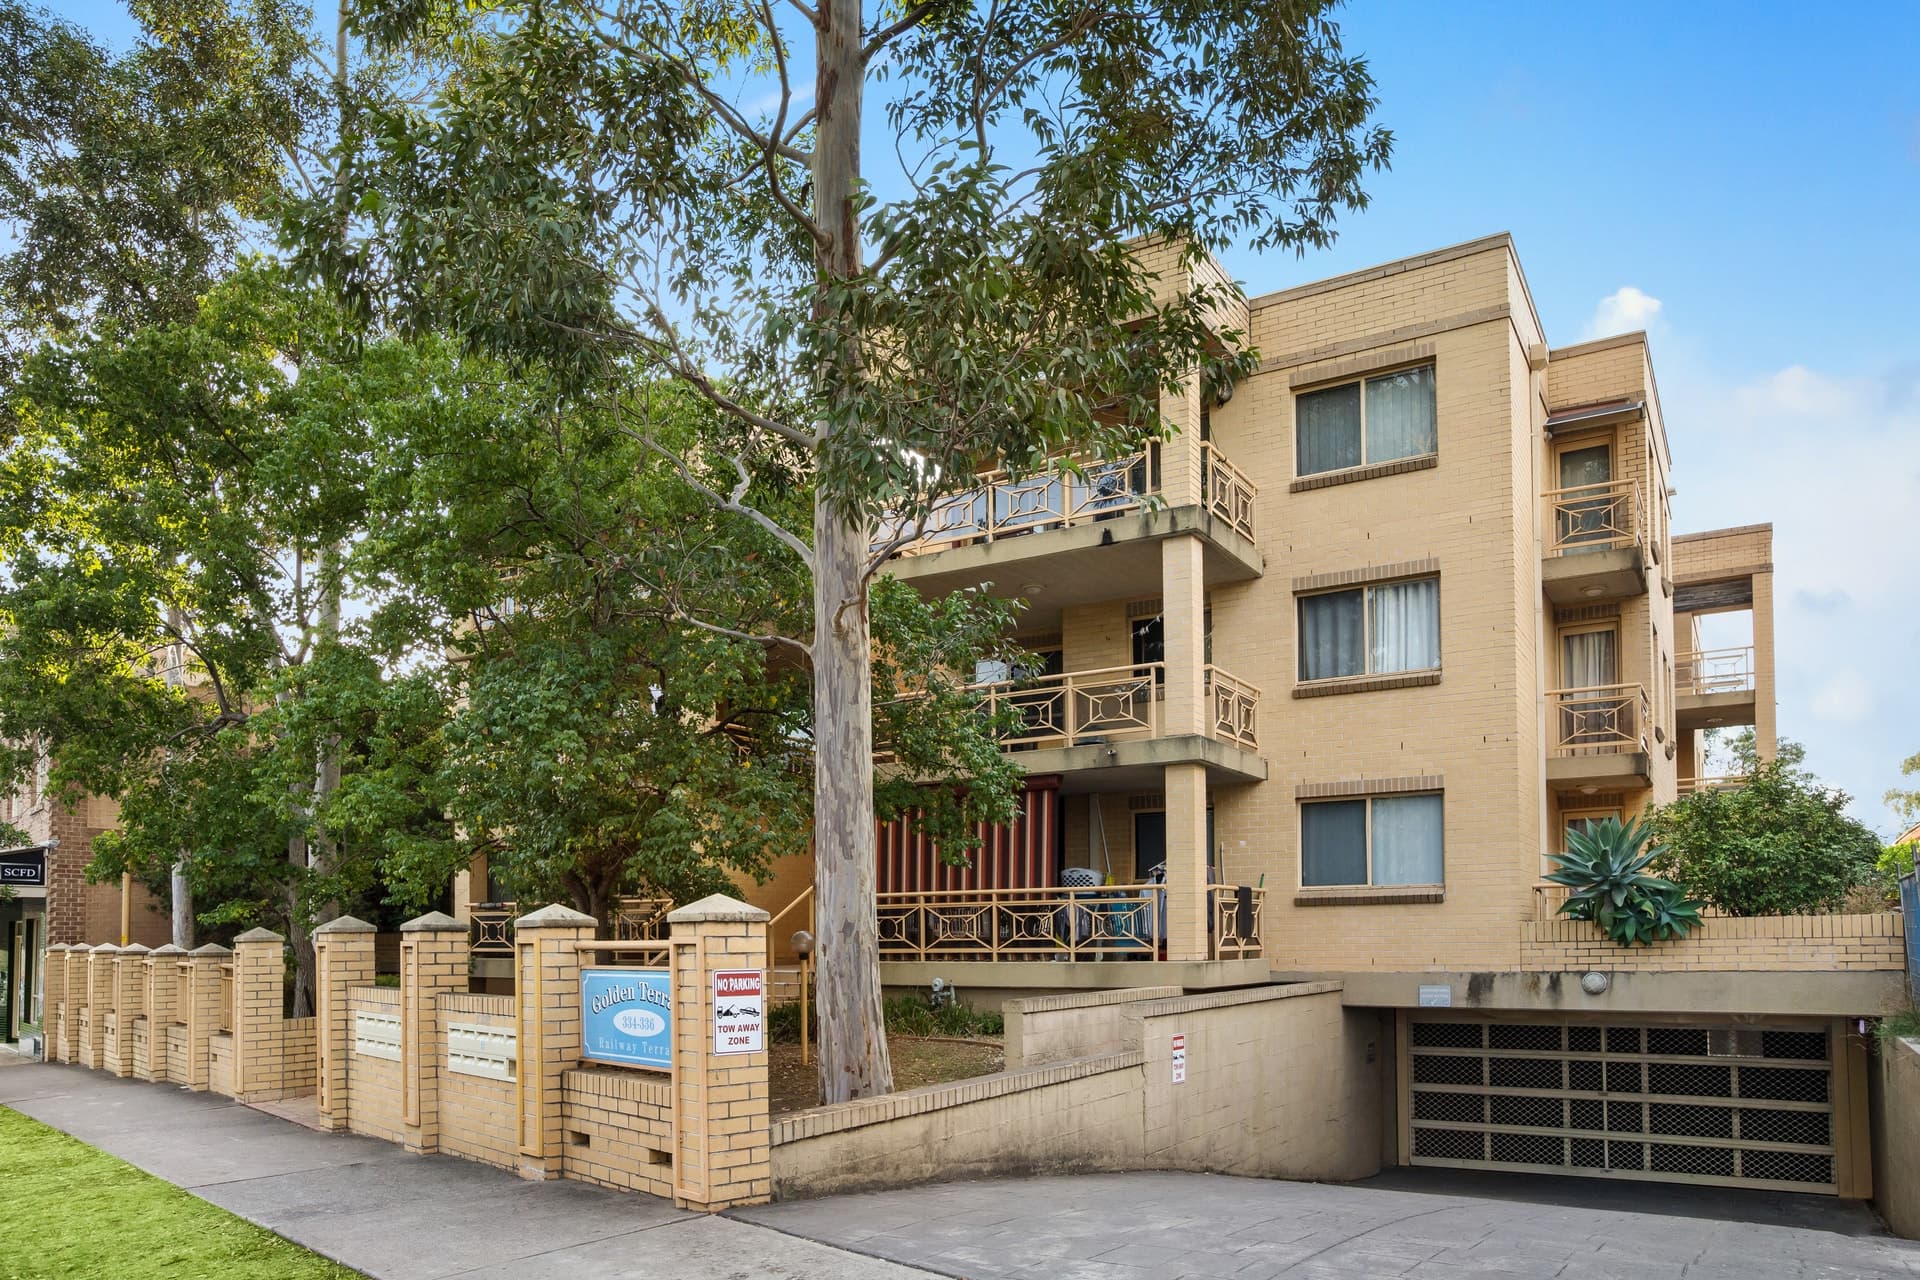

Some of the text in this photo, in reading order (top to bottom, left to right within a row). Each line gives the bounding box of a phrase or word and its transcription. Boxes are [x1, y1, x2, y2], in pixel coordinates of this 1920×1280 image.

[4, 868, 36, 877] SCFD
[718, 977, 760, 991] NO PARKING
[592, 984, 635, 1014] Golden
[622, 1015, 655, 1031] 334-336
[718, 1023, 760, 1033] TOW AWAY
[600, 1037, 637, 1054] Railway
[728, 1036, 750, 1045] ZONE
